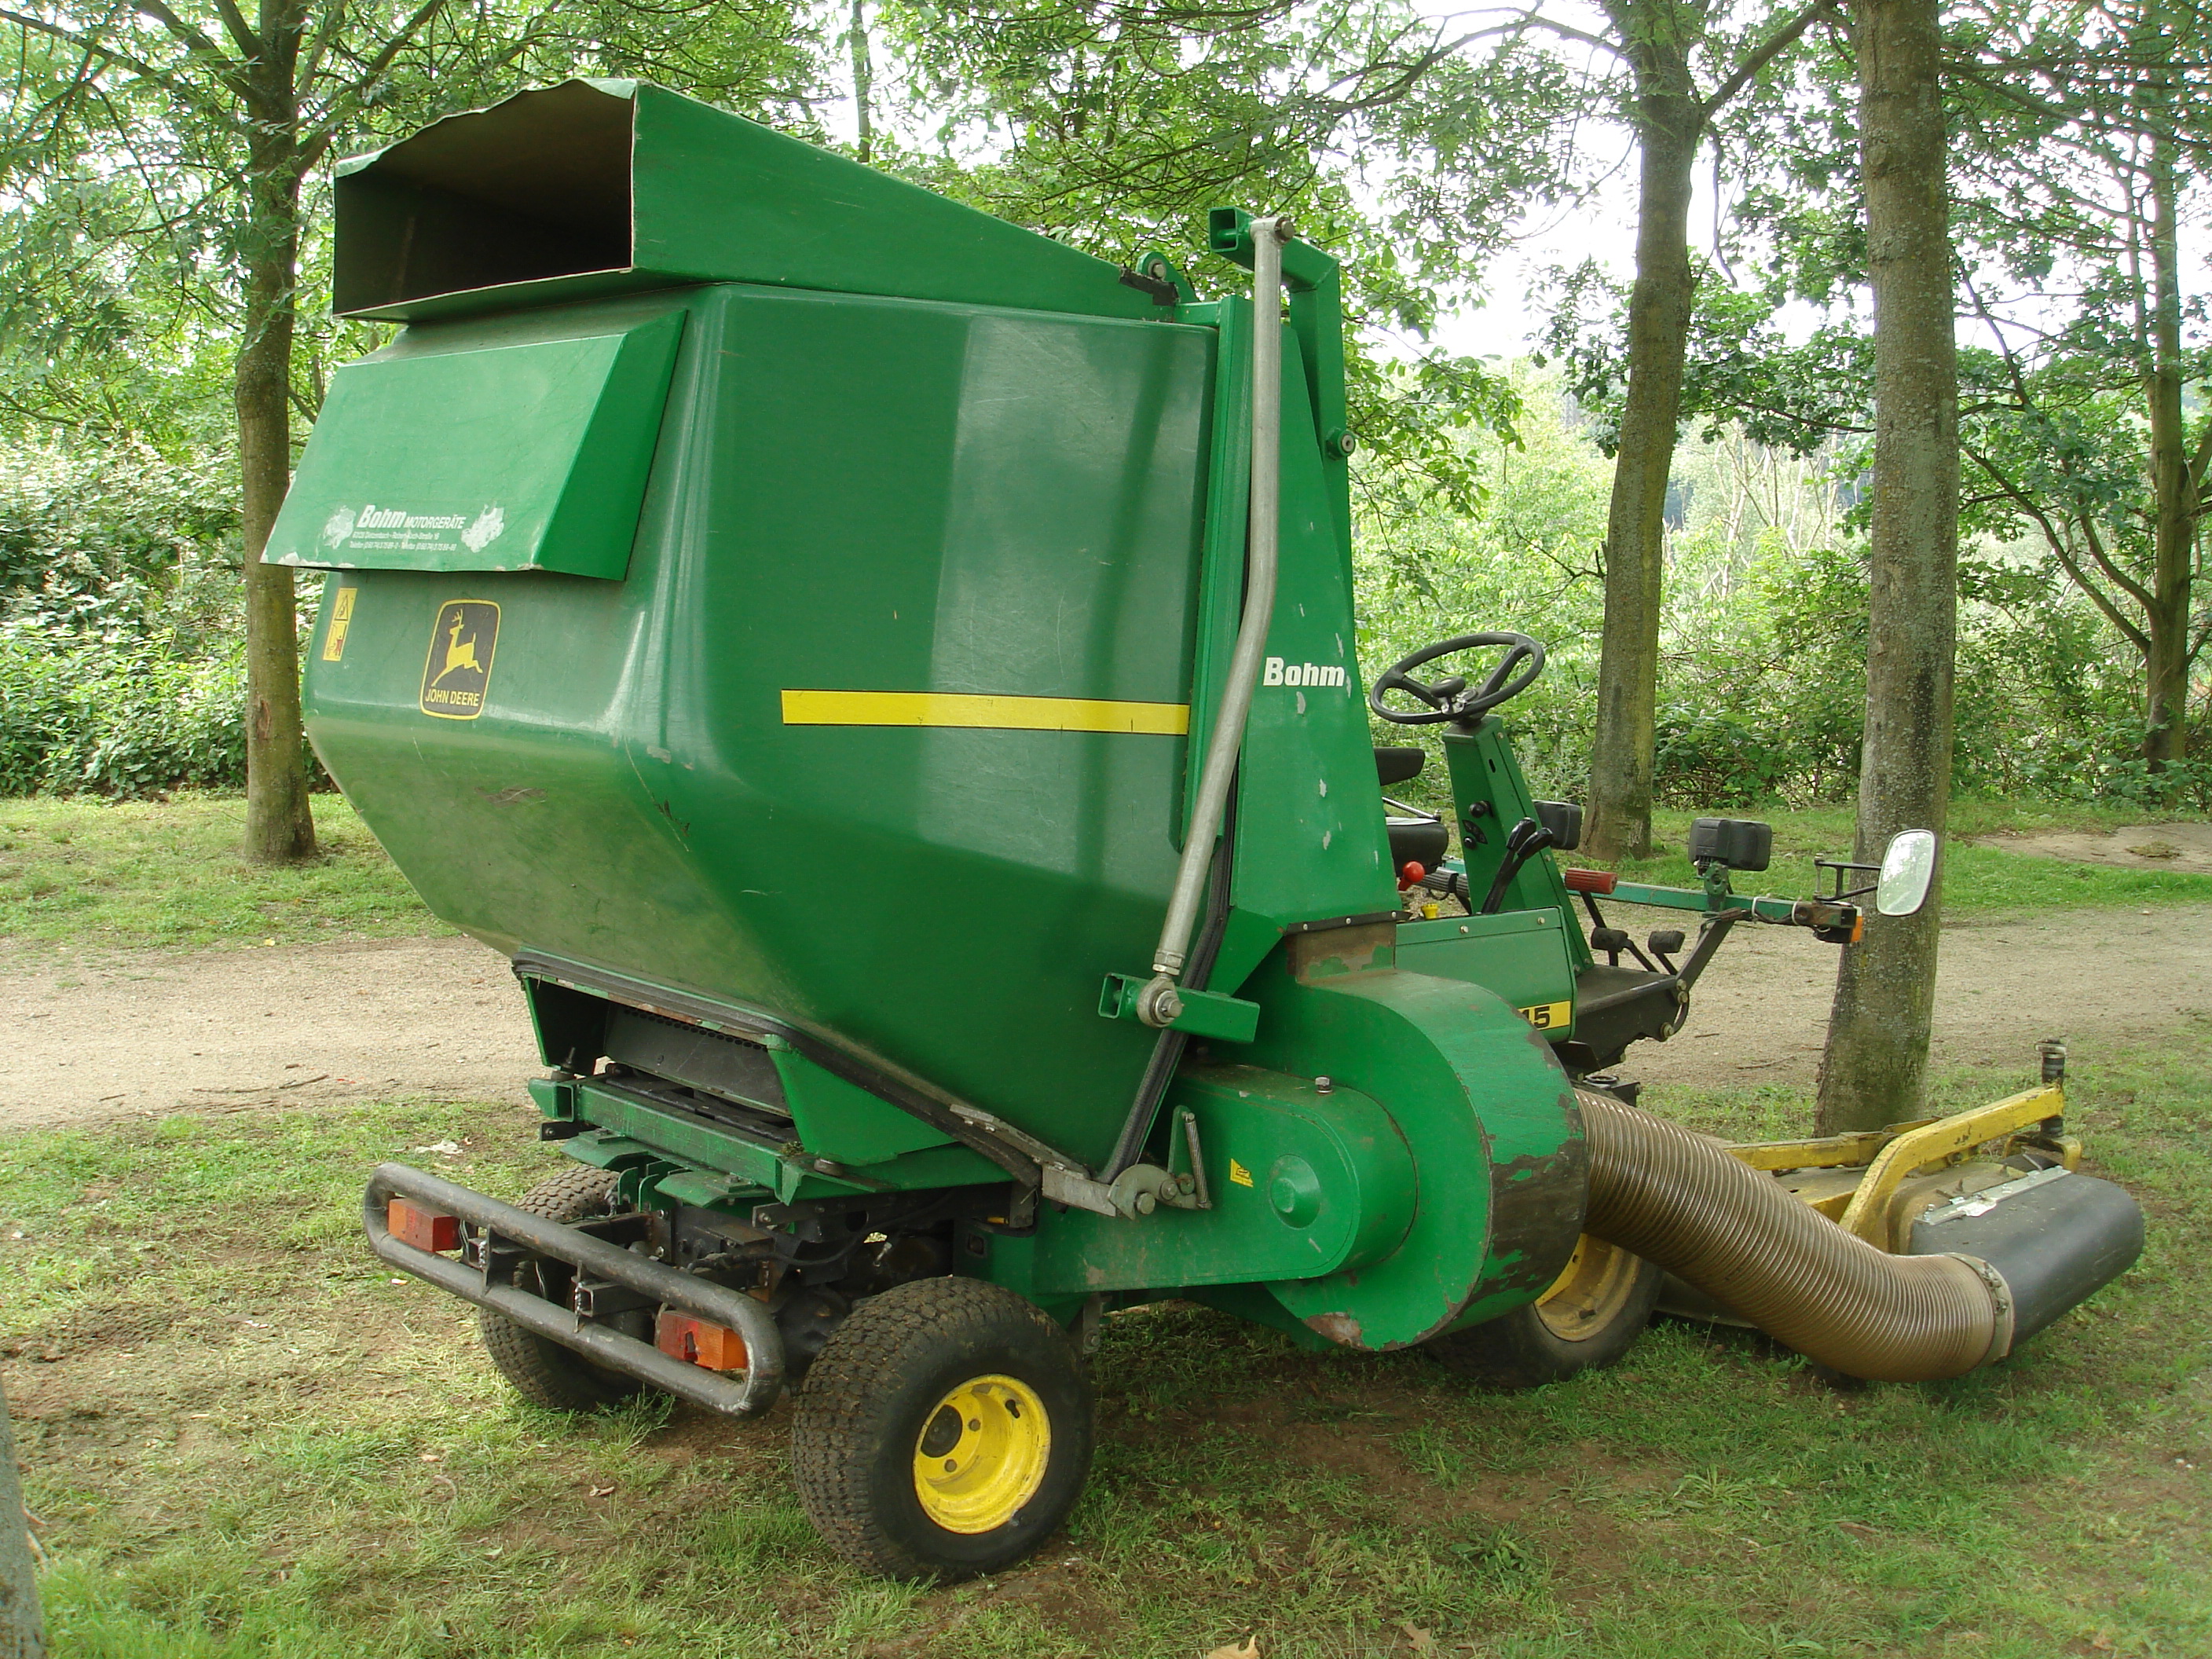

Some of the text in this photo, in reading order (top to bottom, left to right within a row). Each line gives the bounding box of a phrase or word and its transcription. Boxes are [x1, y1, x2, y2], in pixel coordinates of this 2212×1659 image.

[357, 505, 466, 529] Bohm MOTORGERÄTE
[1262, 657, 1345, 687] Bohm
[425, 689, 481, 707] JOHN DEERE
